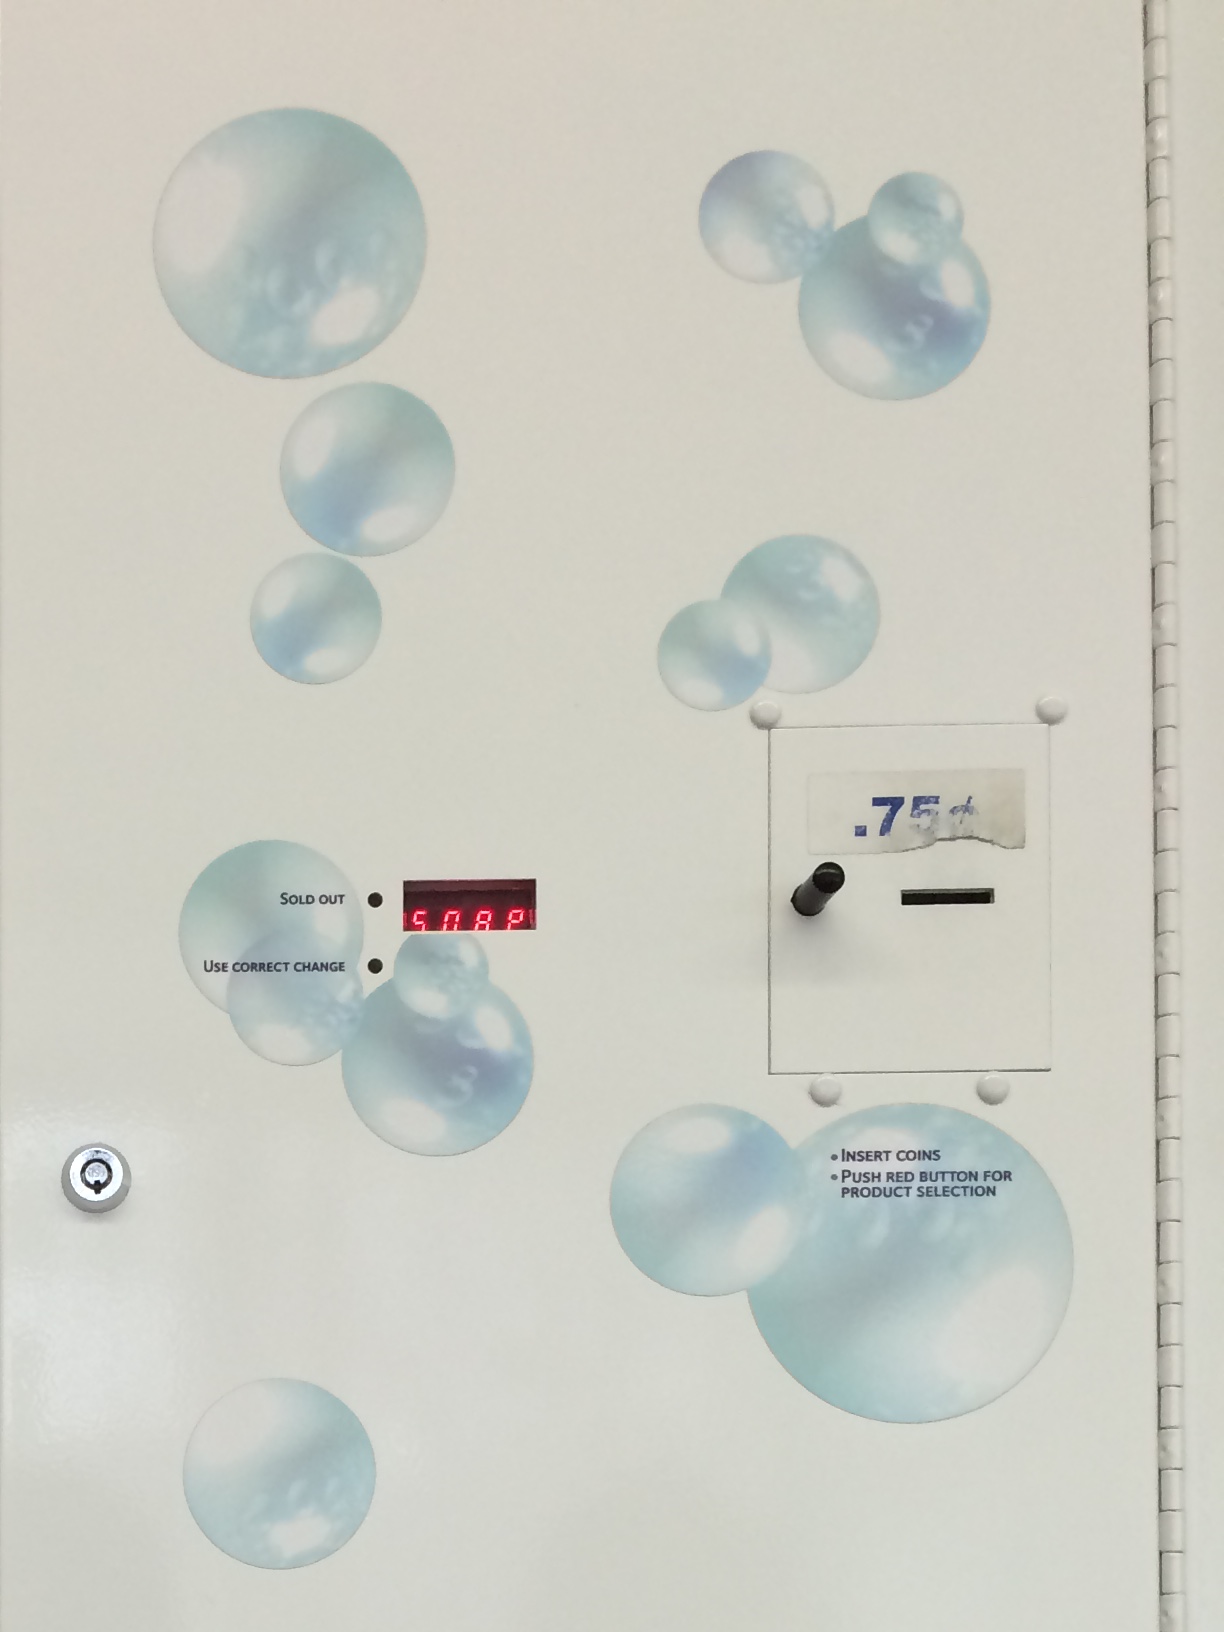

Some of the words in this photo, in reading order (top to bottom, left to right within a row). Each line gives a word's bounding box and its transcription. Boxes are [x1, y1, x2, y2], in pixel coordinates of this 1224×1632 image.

[279, 892, 312, 905] SOLD
[315, 893, 345, 905] OUT
[203, 960, 228, 973] USE
[232, 961, 289, 973] CORRECT
[293, 961, 346, 973] CHANGE
[841, 1148, 892, 1162] INSERT
[896, 1149, 941, 1162] COINS
[841, 1169, 881, 1183] PUSH
[886, 1171, 914, 1182] RED
[919, 1171, 978, 1182] BUTTON
[983, 1170, 1012, 1181] FOR
[841, 1186, 912, 1198] PRODUCT
[916, 1185, 996, 1197] SELECTION
